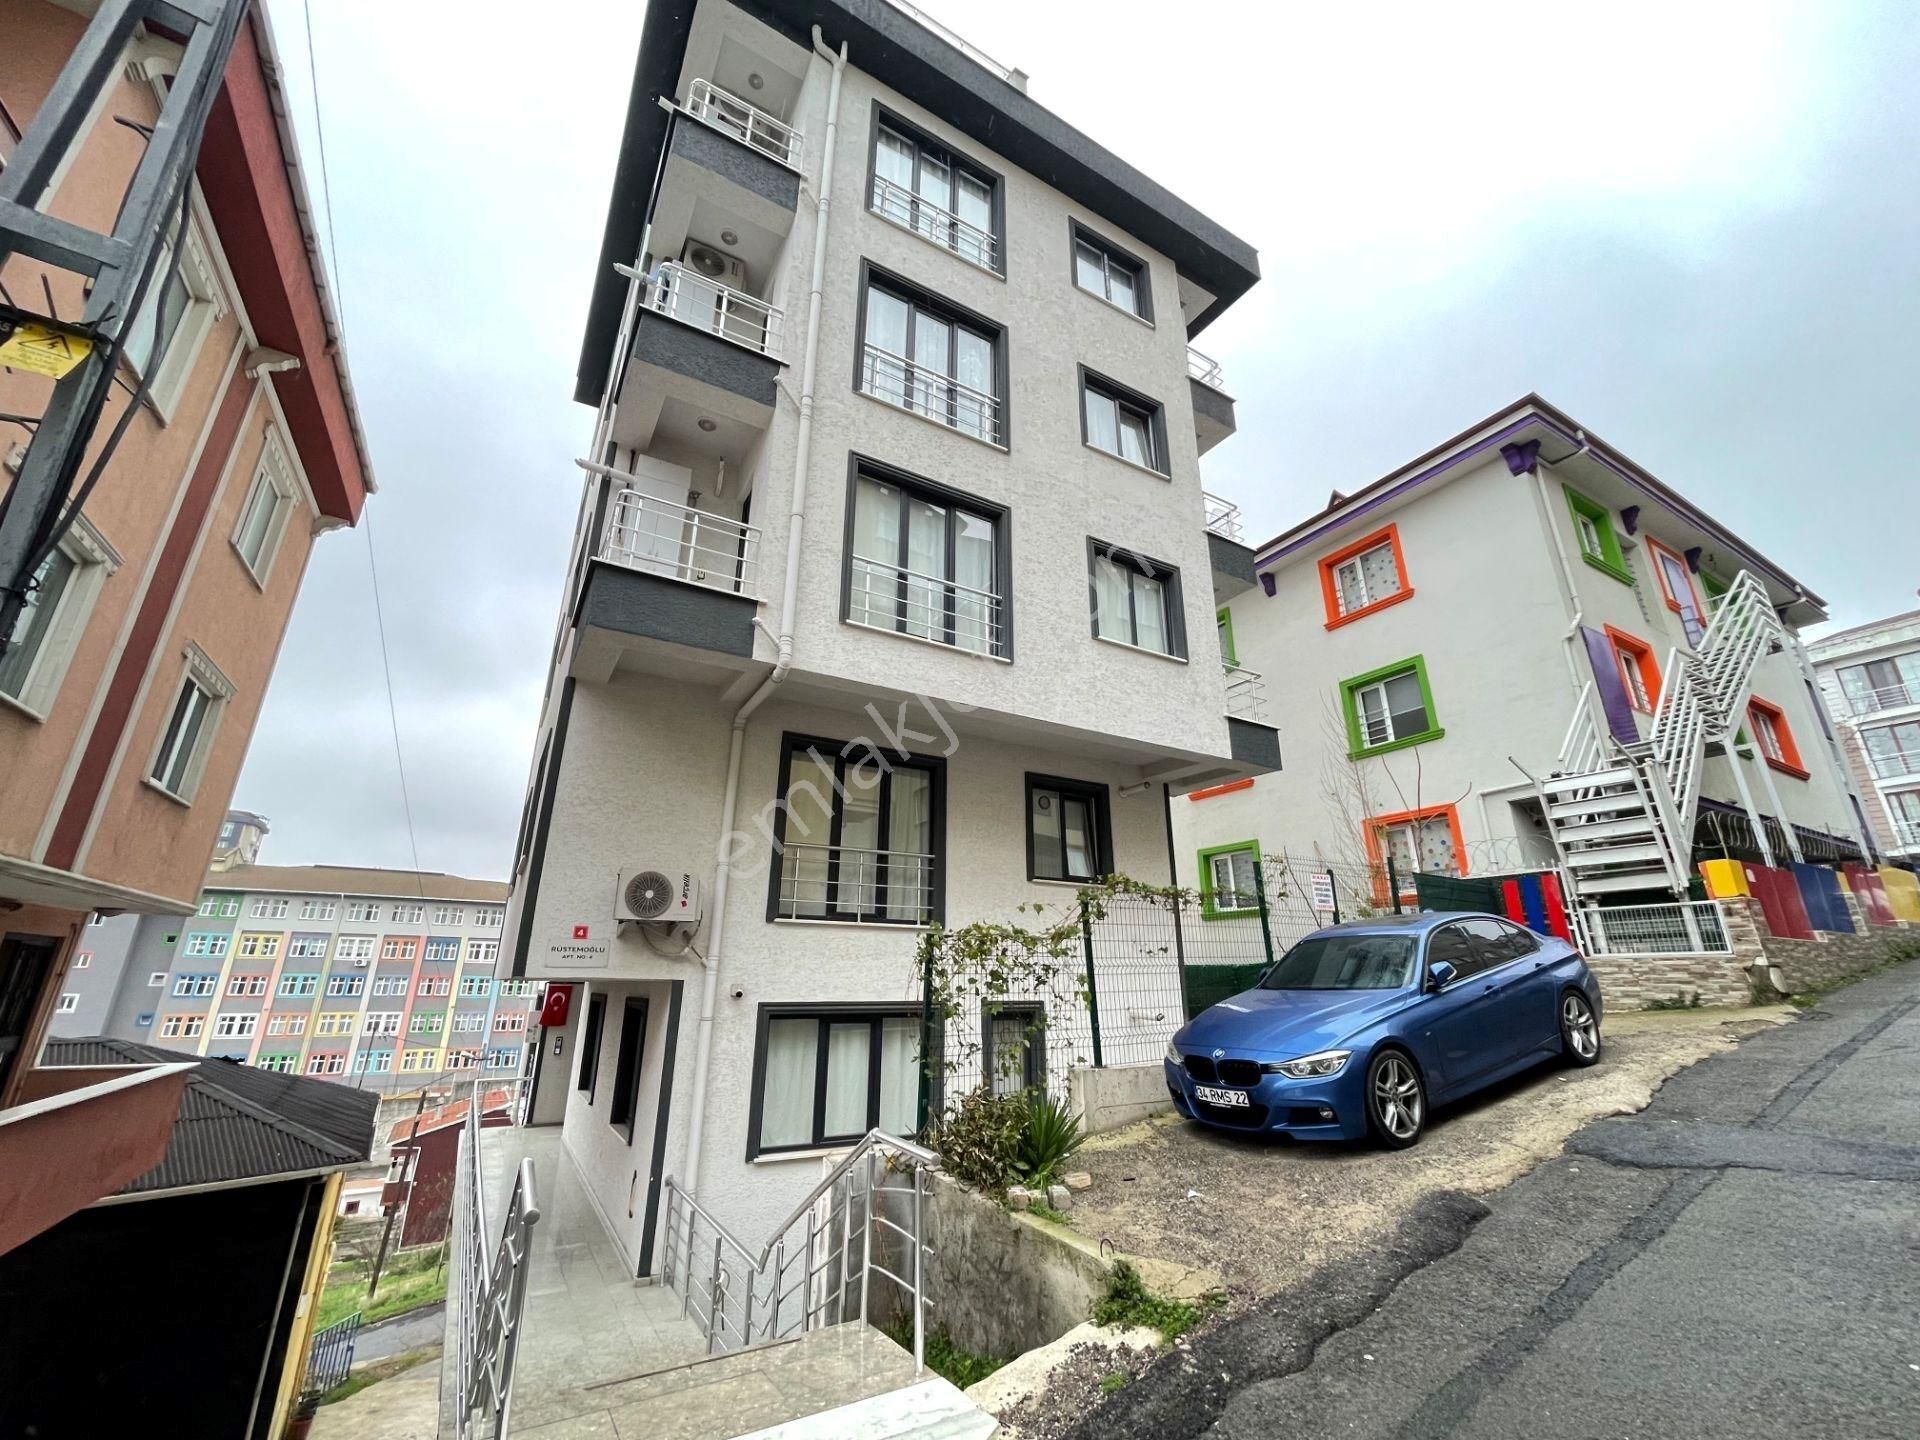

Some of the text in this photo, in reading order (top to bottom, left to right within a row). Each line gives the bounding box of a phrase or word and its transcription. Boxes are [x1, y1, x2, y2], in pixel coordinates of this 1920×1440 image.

[682, 873, 690, 899] arçelik
[551, 945, 605, 953] RÜSTEMOĞLU
[1197, 1087, 1248, 1105] 34 RMS 22
